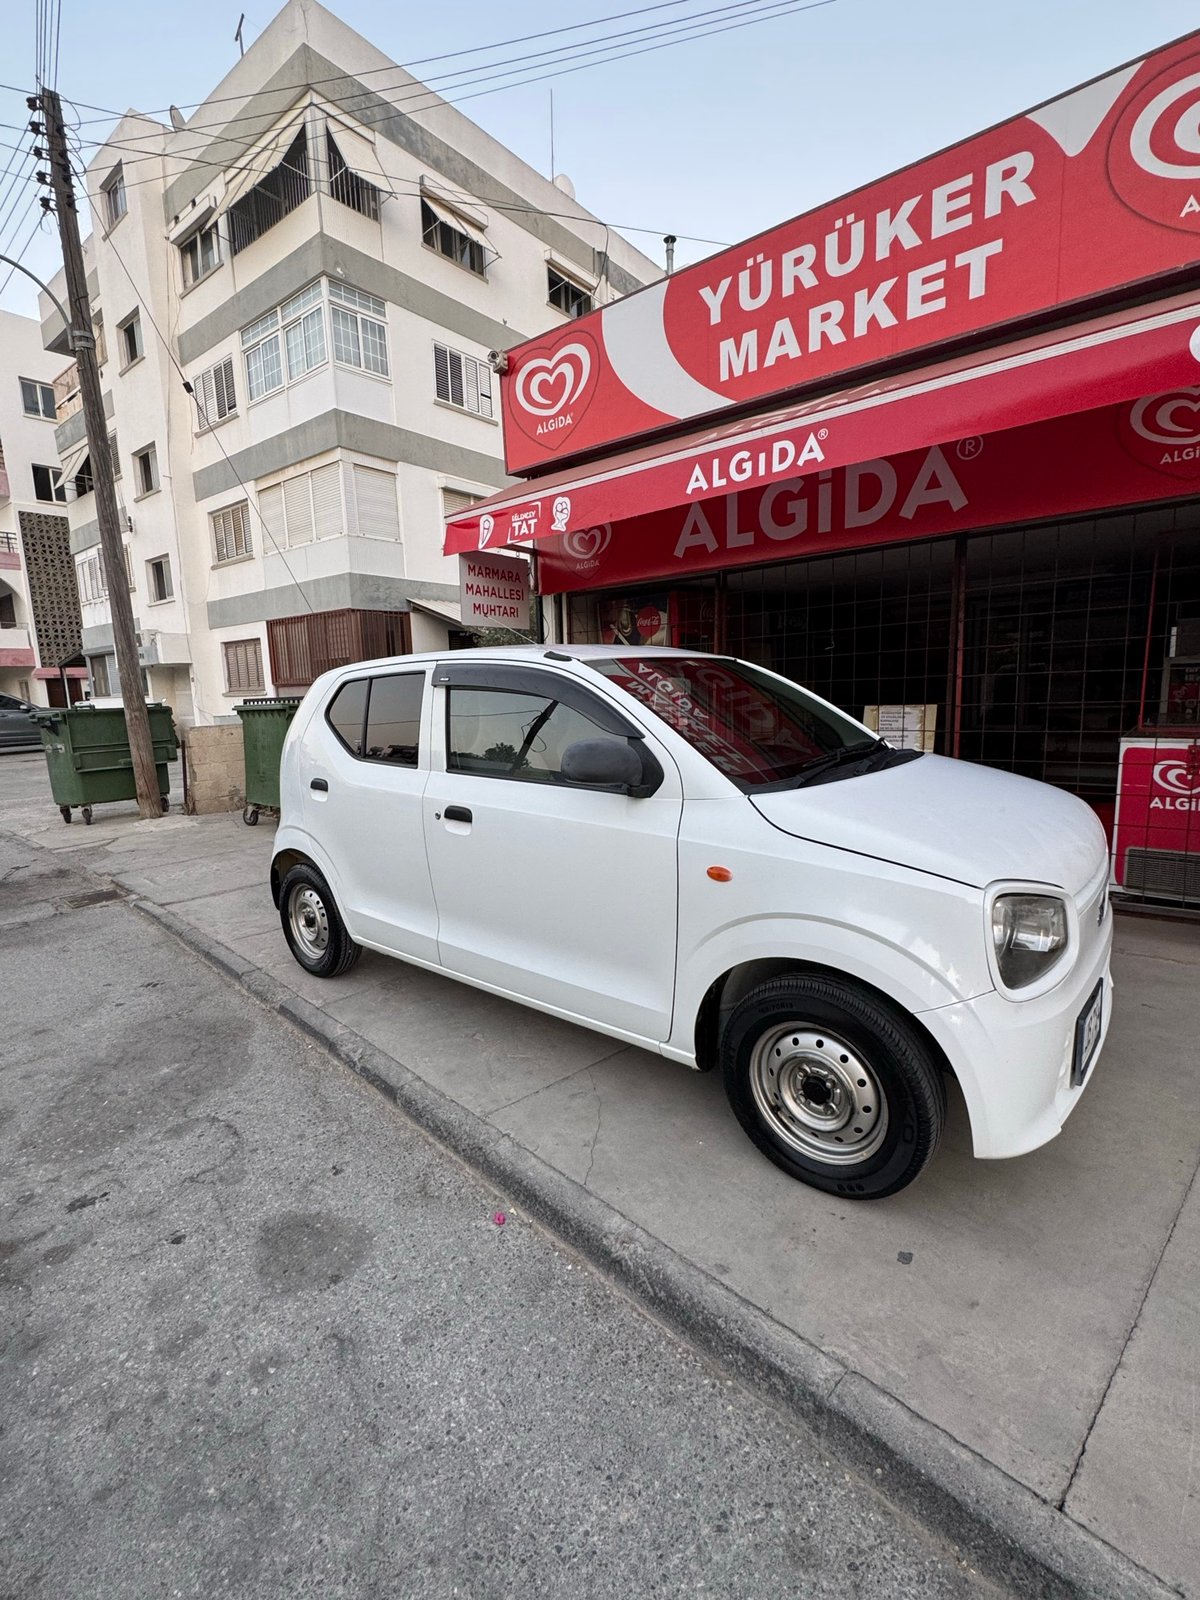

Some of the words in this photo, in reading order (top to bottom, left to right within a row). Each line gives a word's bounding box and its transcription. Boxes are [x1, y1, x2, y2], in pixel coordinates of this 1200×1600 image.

[698, 151, 1037, 326] YÜRÜKER
[719, 238, 1003, 383] MARKET
[511, 518, 538, 537] TAT
[467, 564, 521, 583] MARMARA
[465, 583, 524, 601] MAHALLESİ
[473, 603, 519, 618] MUHTARI
